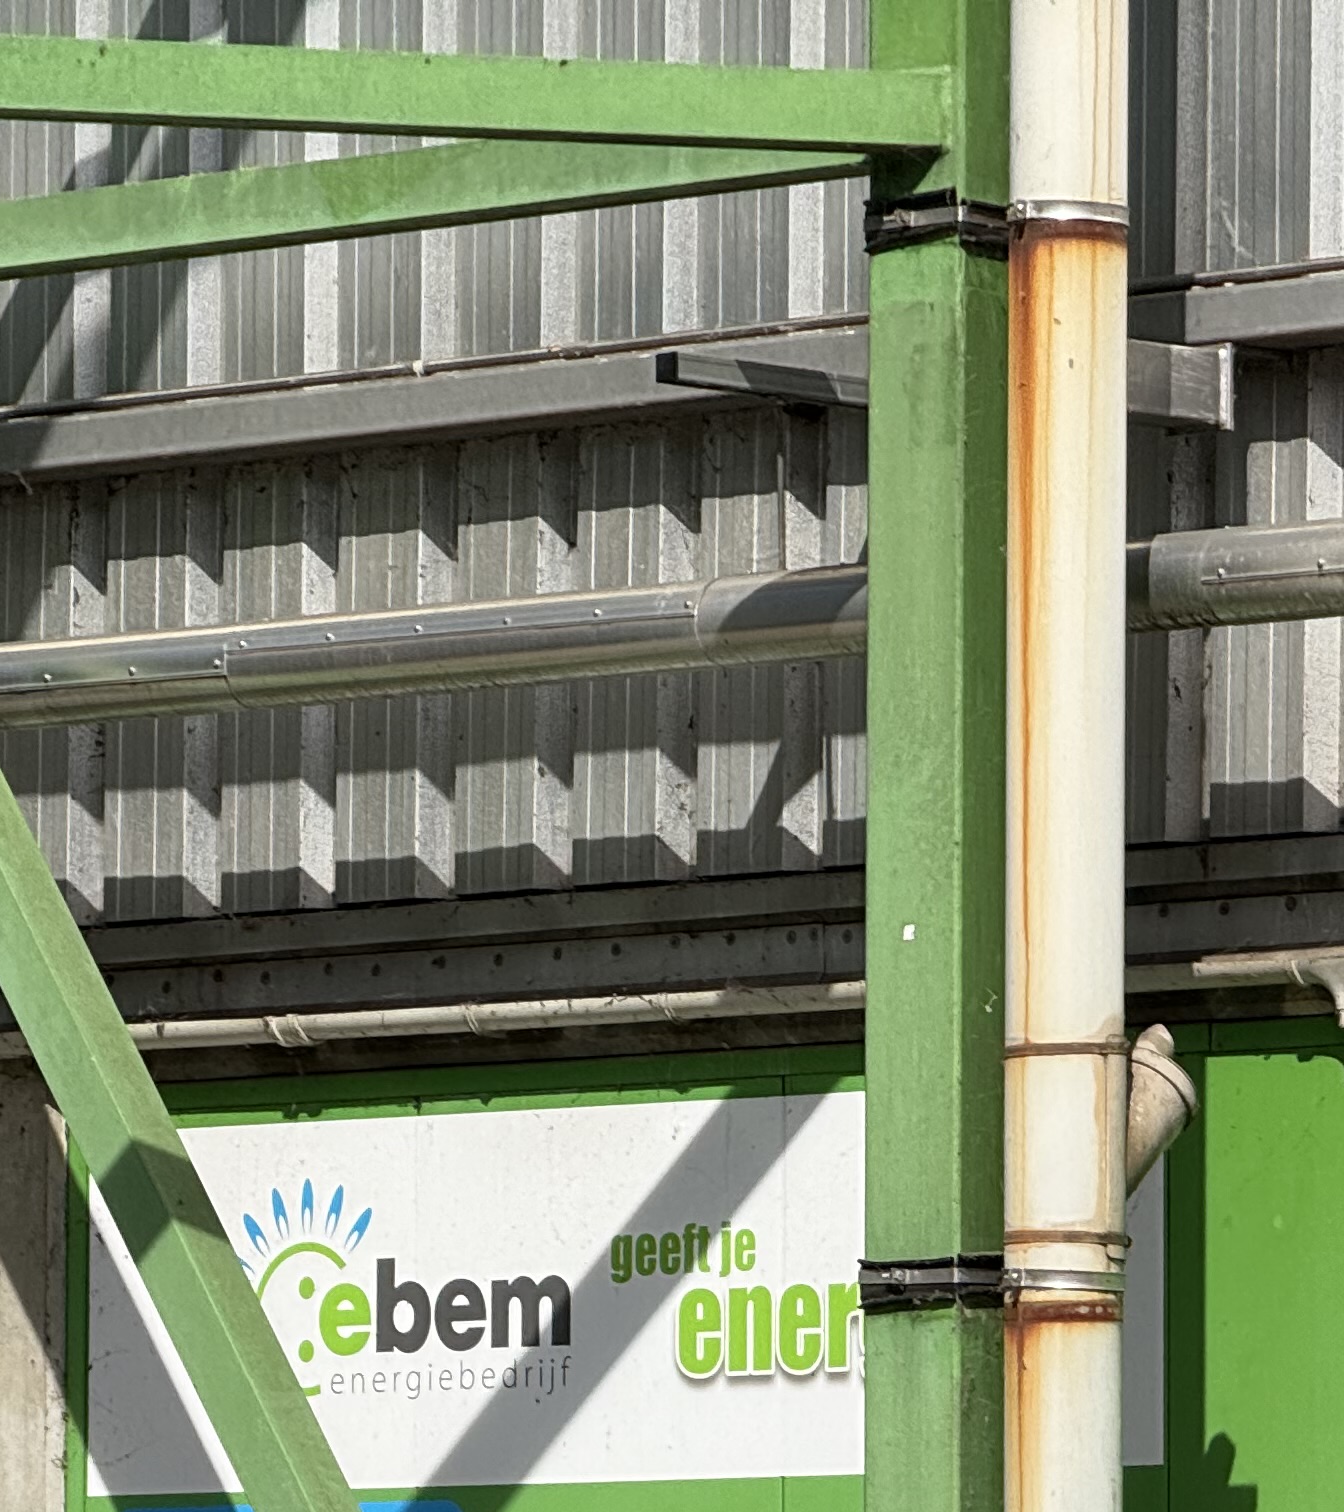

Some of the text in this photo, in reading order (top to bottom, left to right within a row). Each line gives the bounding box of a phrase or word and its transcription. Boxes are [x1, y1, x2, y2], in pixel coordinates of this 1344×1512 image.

[610, 1221, 756, 1284] geeft je
[318, 1257, 571, 1356] ebem
[330, 1355, 572, 1399] energiebedrijf
